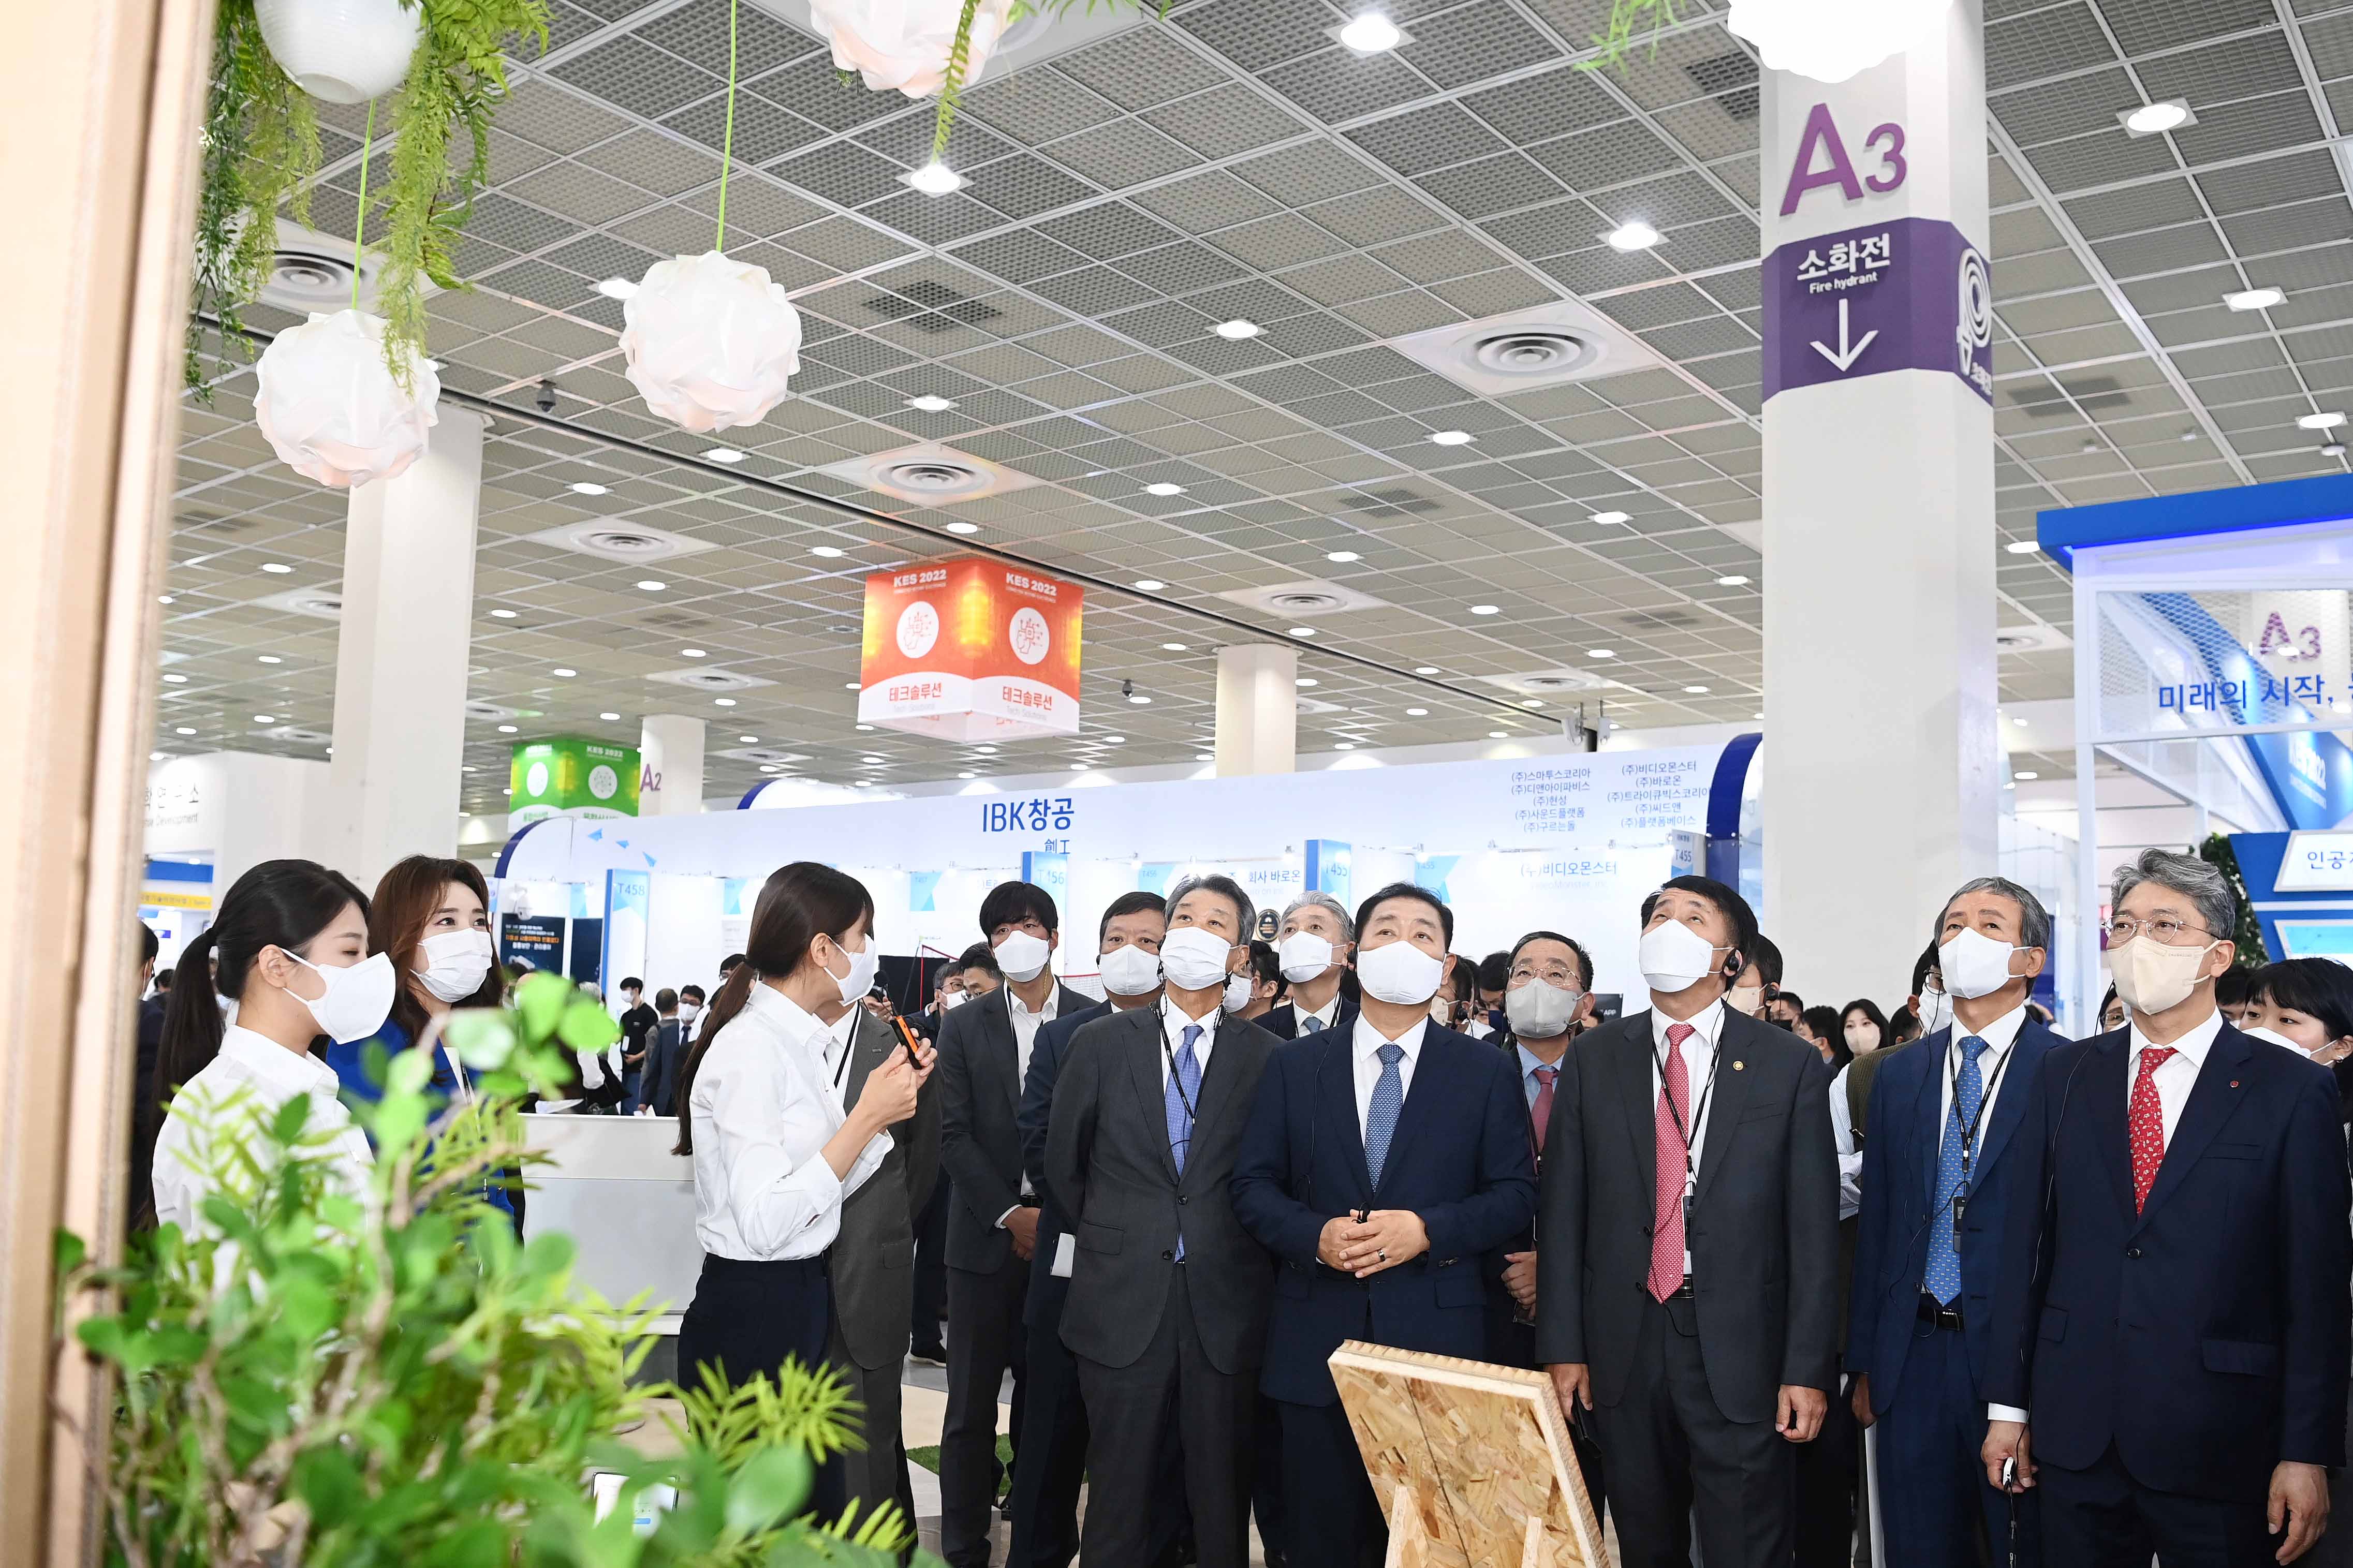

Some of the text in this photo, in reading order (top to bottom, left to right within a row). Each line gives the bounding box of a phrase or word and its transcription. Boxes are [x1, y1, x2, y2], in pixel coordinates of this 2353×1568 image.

[1780, 102, 1907, 216] A3
[1797, 233, 1890, 280] 소화전
[1810, 271, 1878, 294] Fire hydrant
[894, 569, 947, 587] KES 2022
[1006, 572, 1030, 588] KES
[1031, 580, 1057, 596] 2022
[2260, 611, 2321, 662] A3
[889, 683, 942, 702] 테크솔루션
[1003, 686, 1052, 711] 테크솔루션
[2159, 680, 2247, 714] 미래의
[2261, 674, 2334, 708] 시작,
[640, 764, 661, 792] A2
[1622, 760, 1696, 775] (주)비디오몬스터
[1636, 775, 1682, 788] (주)바로온
[983, 797, 1075, 833] IBK창공
[1675, 849, 1692, 862] T455
[1271, 869, 1301, 883] 바로온
[1521, 861, 1616, 877] (주)비디오몬스터
[616, 882, 645, 896] T458
